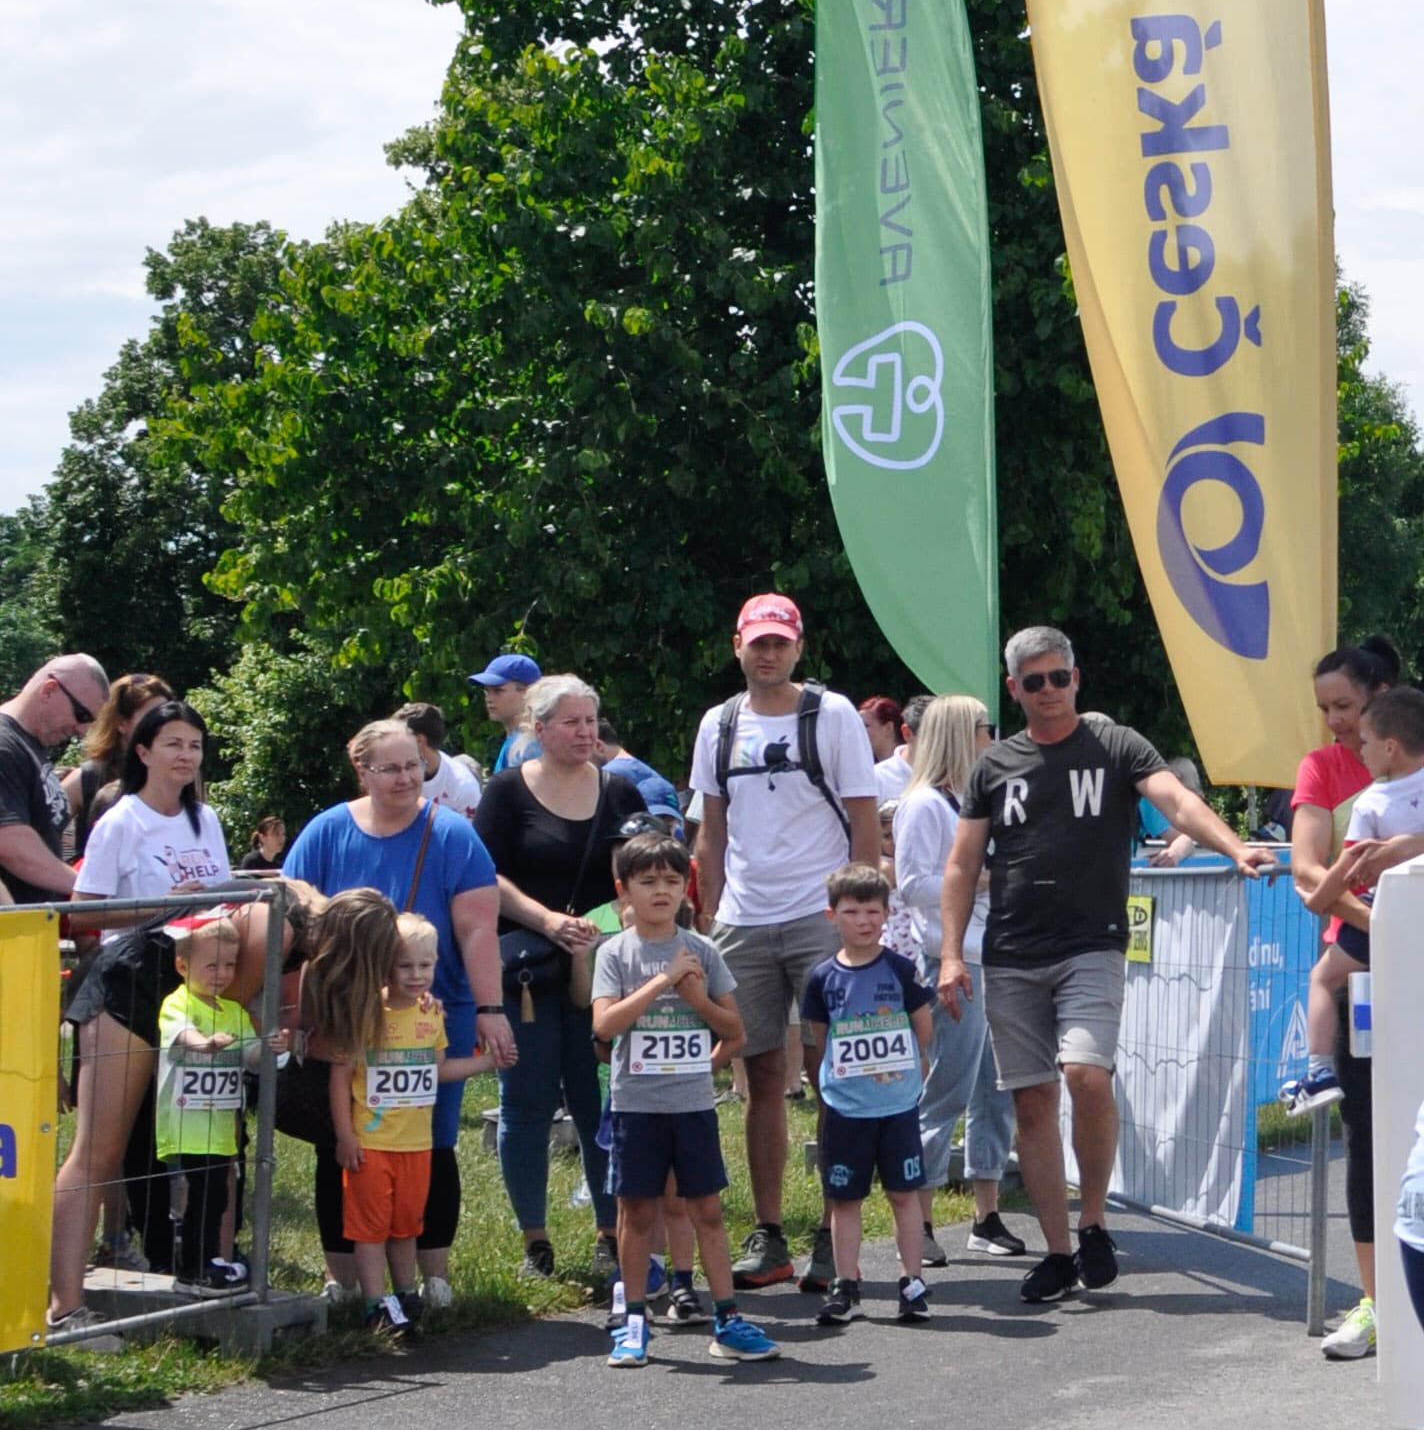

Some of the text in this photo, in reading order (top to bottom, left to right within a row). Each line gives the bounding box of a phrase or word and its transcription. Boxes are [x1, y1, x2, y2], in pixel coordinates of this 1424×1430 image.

[1003, 768, 1105, 826] R W
[184, 864, 220, 880] HELP
[641, 1034, 702, 1060] 2136
[838, 1033, 907, 1063] 2004
[182, 1071, 239, 1095] 2079
[375, 1069, 433, 1093] 2076
